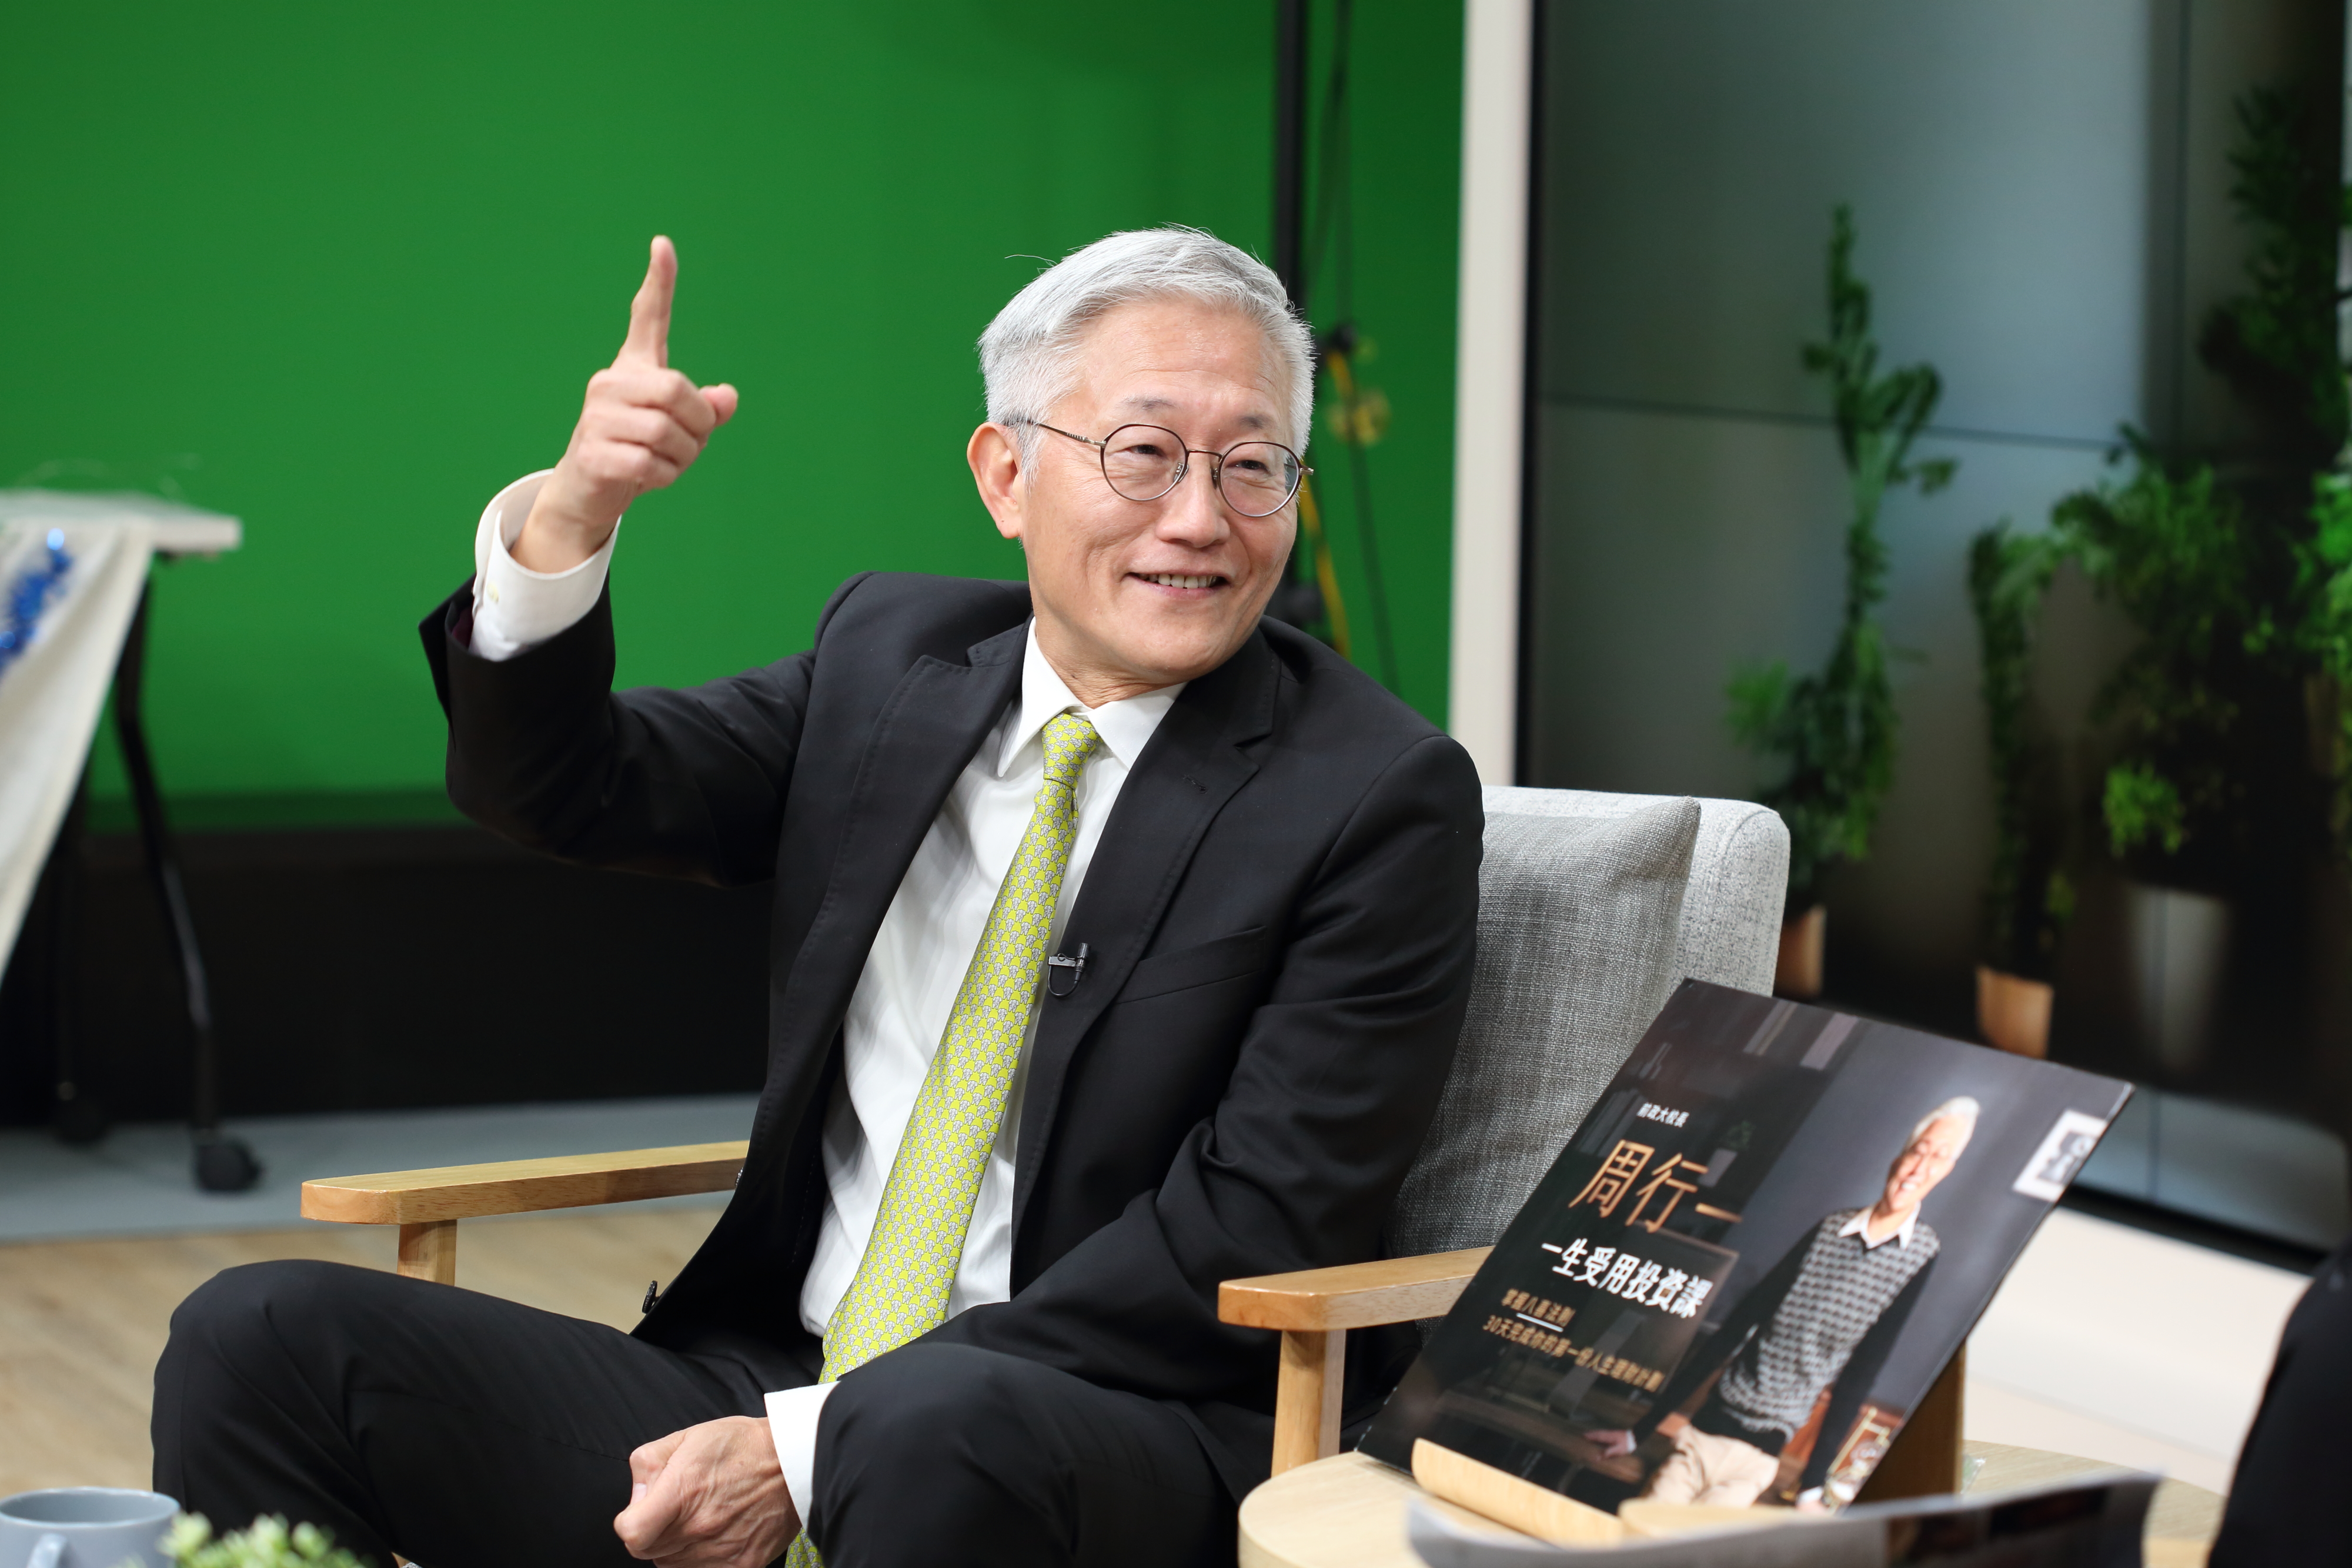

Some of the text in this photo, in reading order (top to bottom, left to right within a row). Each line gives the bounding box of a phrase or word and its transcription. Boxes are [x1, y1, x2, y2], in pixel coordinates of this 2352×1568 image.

[1568, 1139, 1742, 1233] 周行一
[1541, 1238, 1713, 1318] 一生受用投資課
